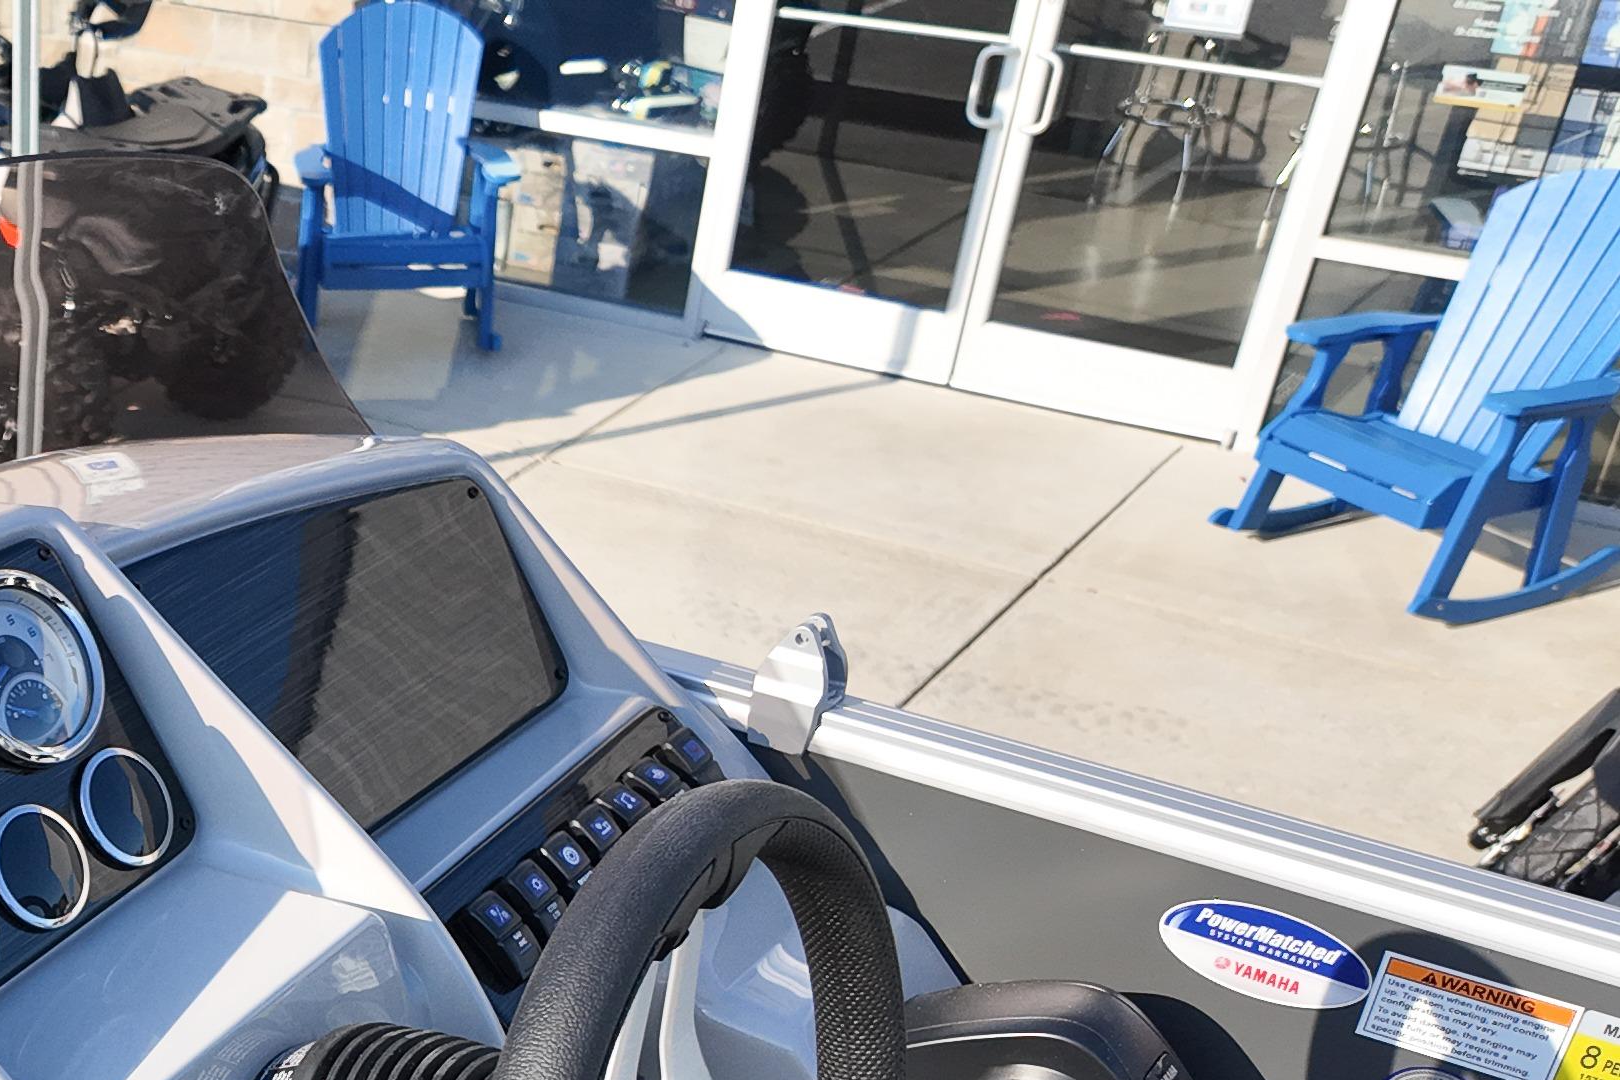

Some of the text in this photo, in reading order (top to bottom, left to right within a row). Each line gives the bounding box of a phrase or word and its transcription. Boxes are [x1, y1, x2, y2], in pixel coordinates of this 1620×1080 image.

[1195, 907, 1342, 966] PowerMatched
[1209, 929, 1321, 970] SYSTEM WARRANTY
[1234, 961, 1300, 995] YAMAHA
[1441, 975, 1535, 1014] WARNING
[1388, 978, 1405, 989] Use
[1408, 985, 1444, 1000] caution
[1446, 996, 1472, 1009] when
[1475, 1004, 1520, 1023] trimming
[1374, 1015, 1390, 1024] not
[1391, 1019, 1404, 1028] tilt
[1442, 1036, 1462, 1047] may
[1464, 1042, 1500, 1057] require
[1378, 1005, 1389, 1014] To
[1462, 1031, 1478, 1041] the
[1481, 1038, 1514, 1051] engine
[1516, 1048, 1538, 1060] may
[1452, 1018, 1473, 1029] may
[1491, 1019, 1511, 1030] and
[1513, 1026, 1549, 1041] control
[1451, 1047, 1481, 1061] before
[1580, 1045, 1601, 1069] 8
